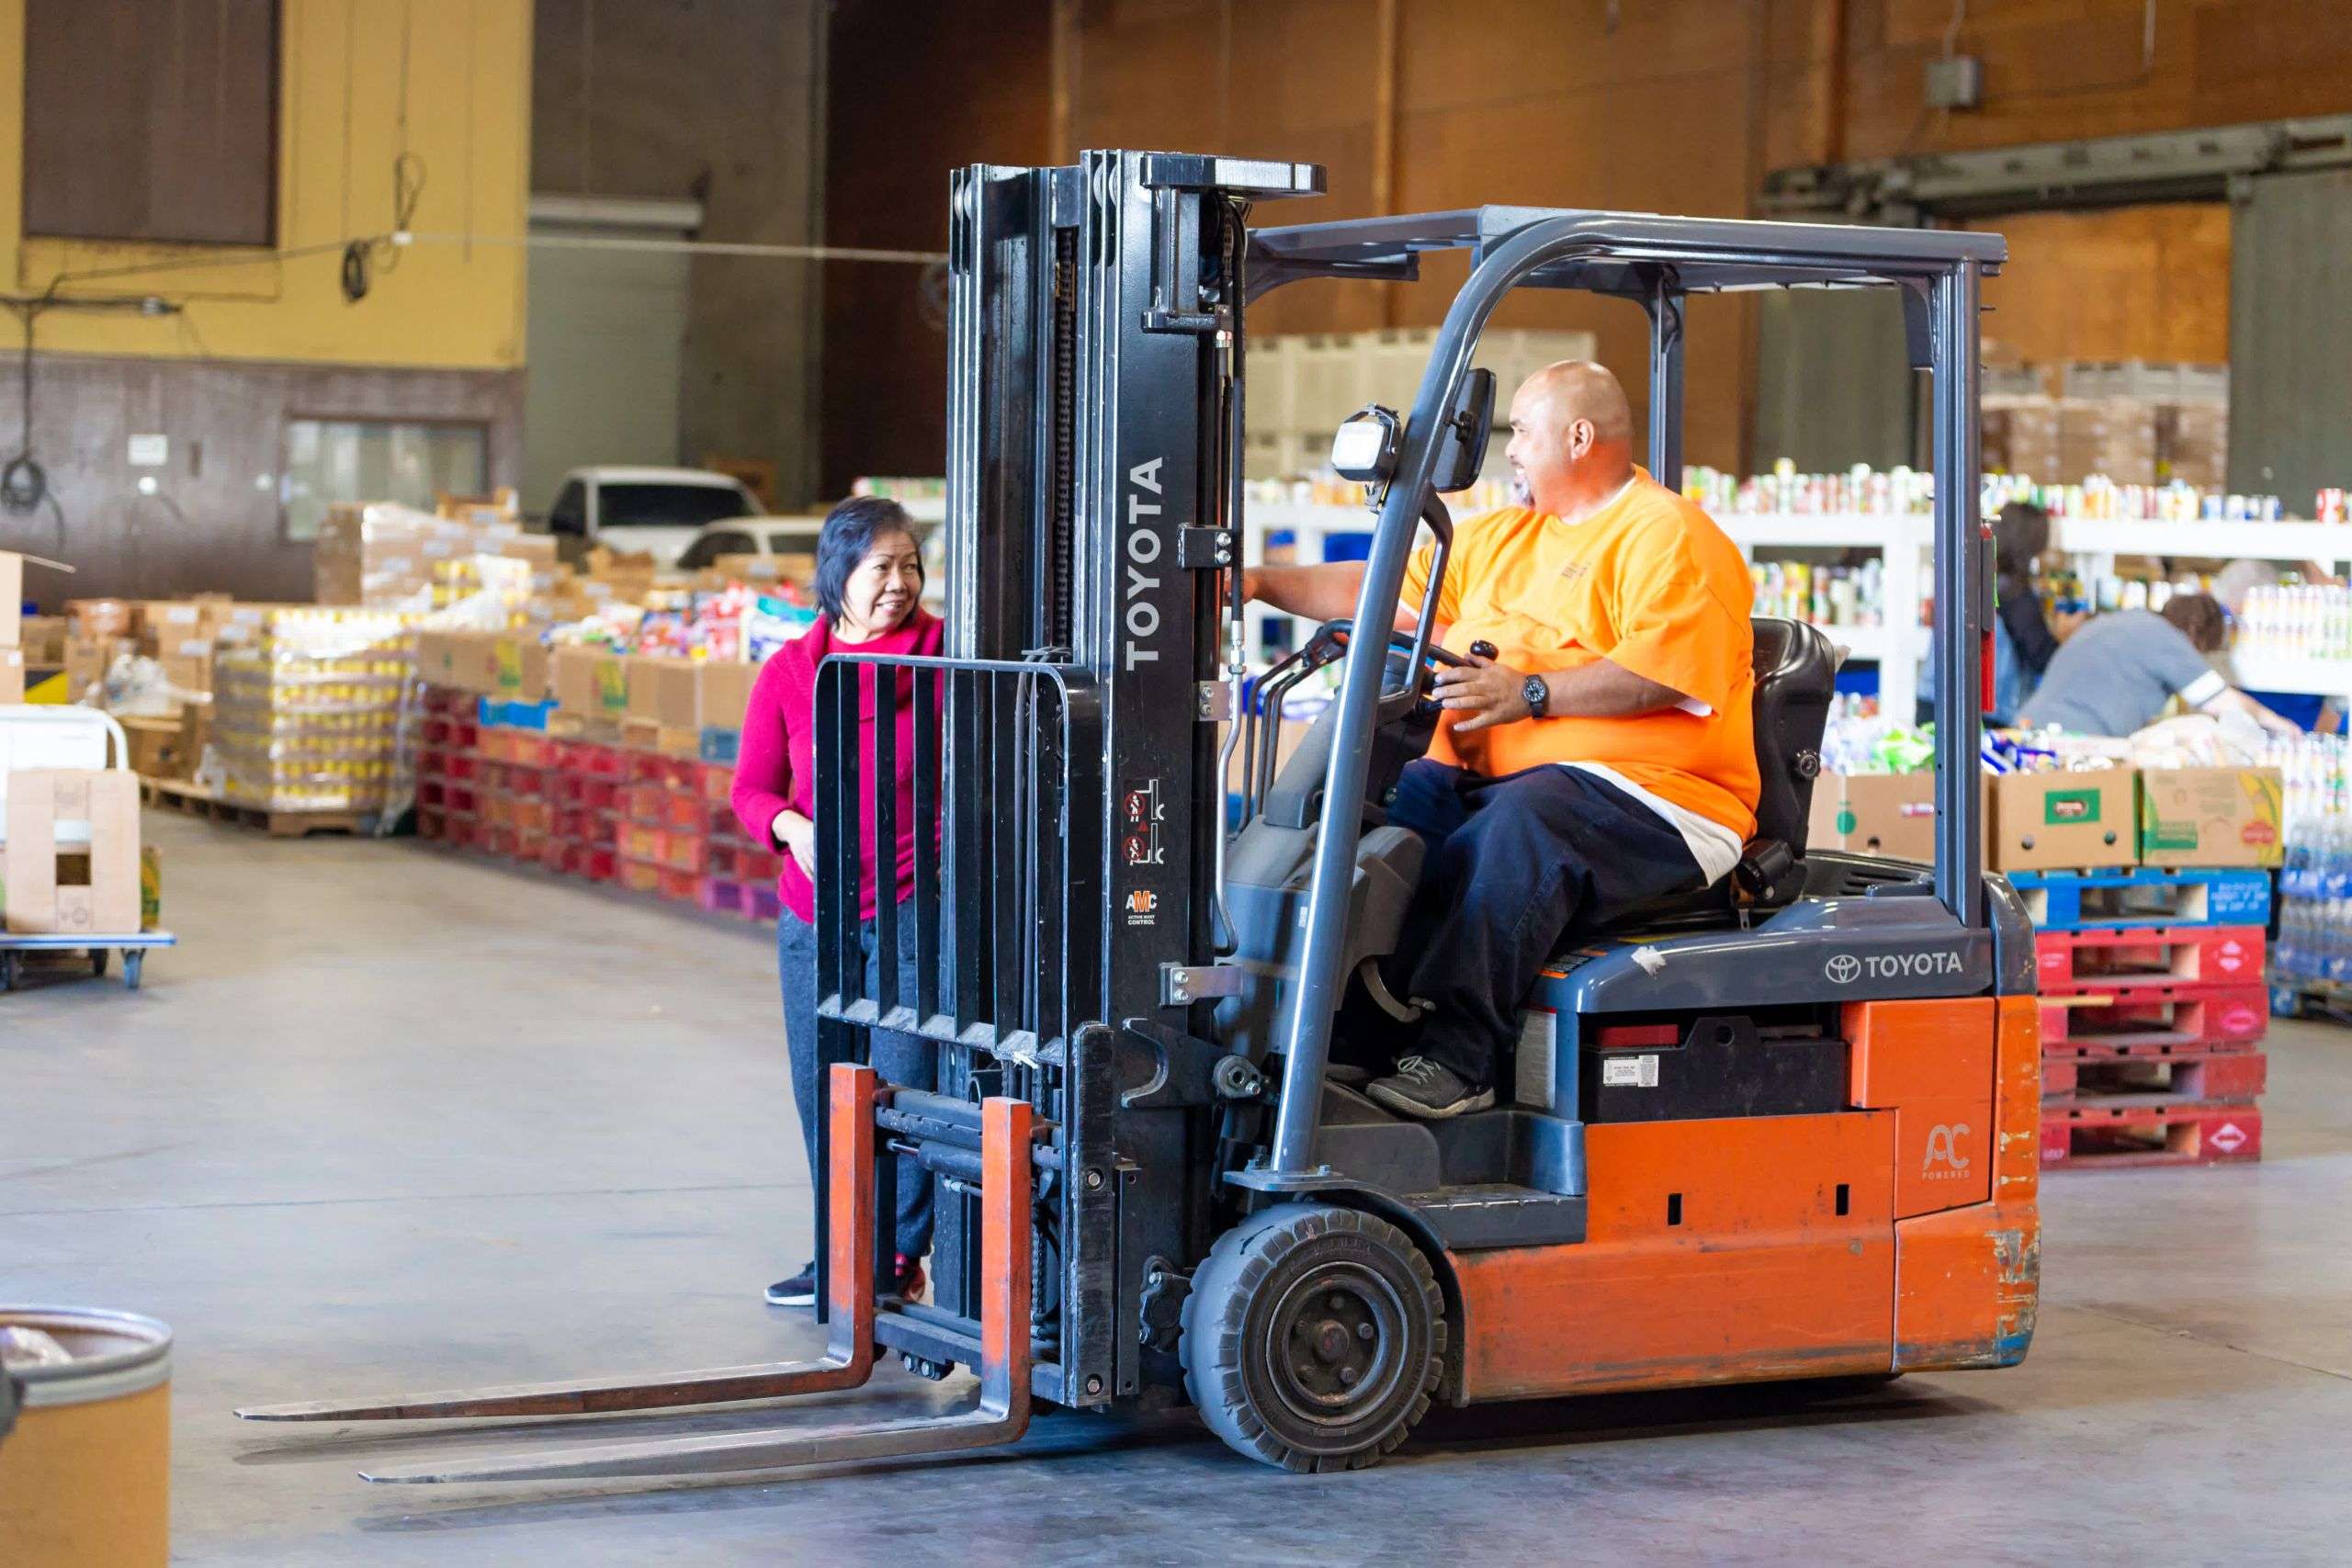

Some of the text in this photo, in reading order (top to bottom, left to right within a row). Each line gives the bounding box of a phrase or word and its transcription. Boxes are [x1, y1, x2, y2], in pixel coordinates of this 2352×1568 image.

[1125, 457, 1163, 671] TOYOTA
[1125, 890, 1158, 912] AMC
[1864, 952, 1963, 978] TOYOTA
[1922, 1124, 1971, 1169] AC
[1922, 1170, 1971, 1179] POWERED
